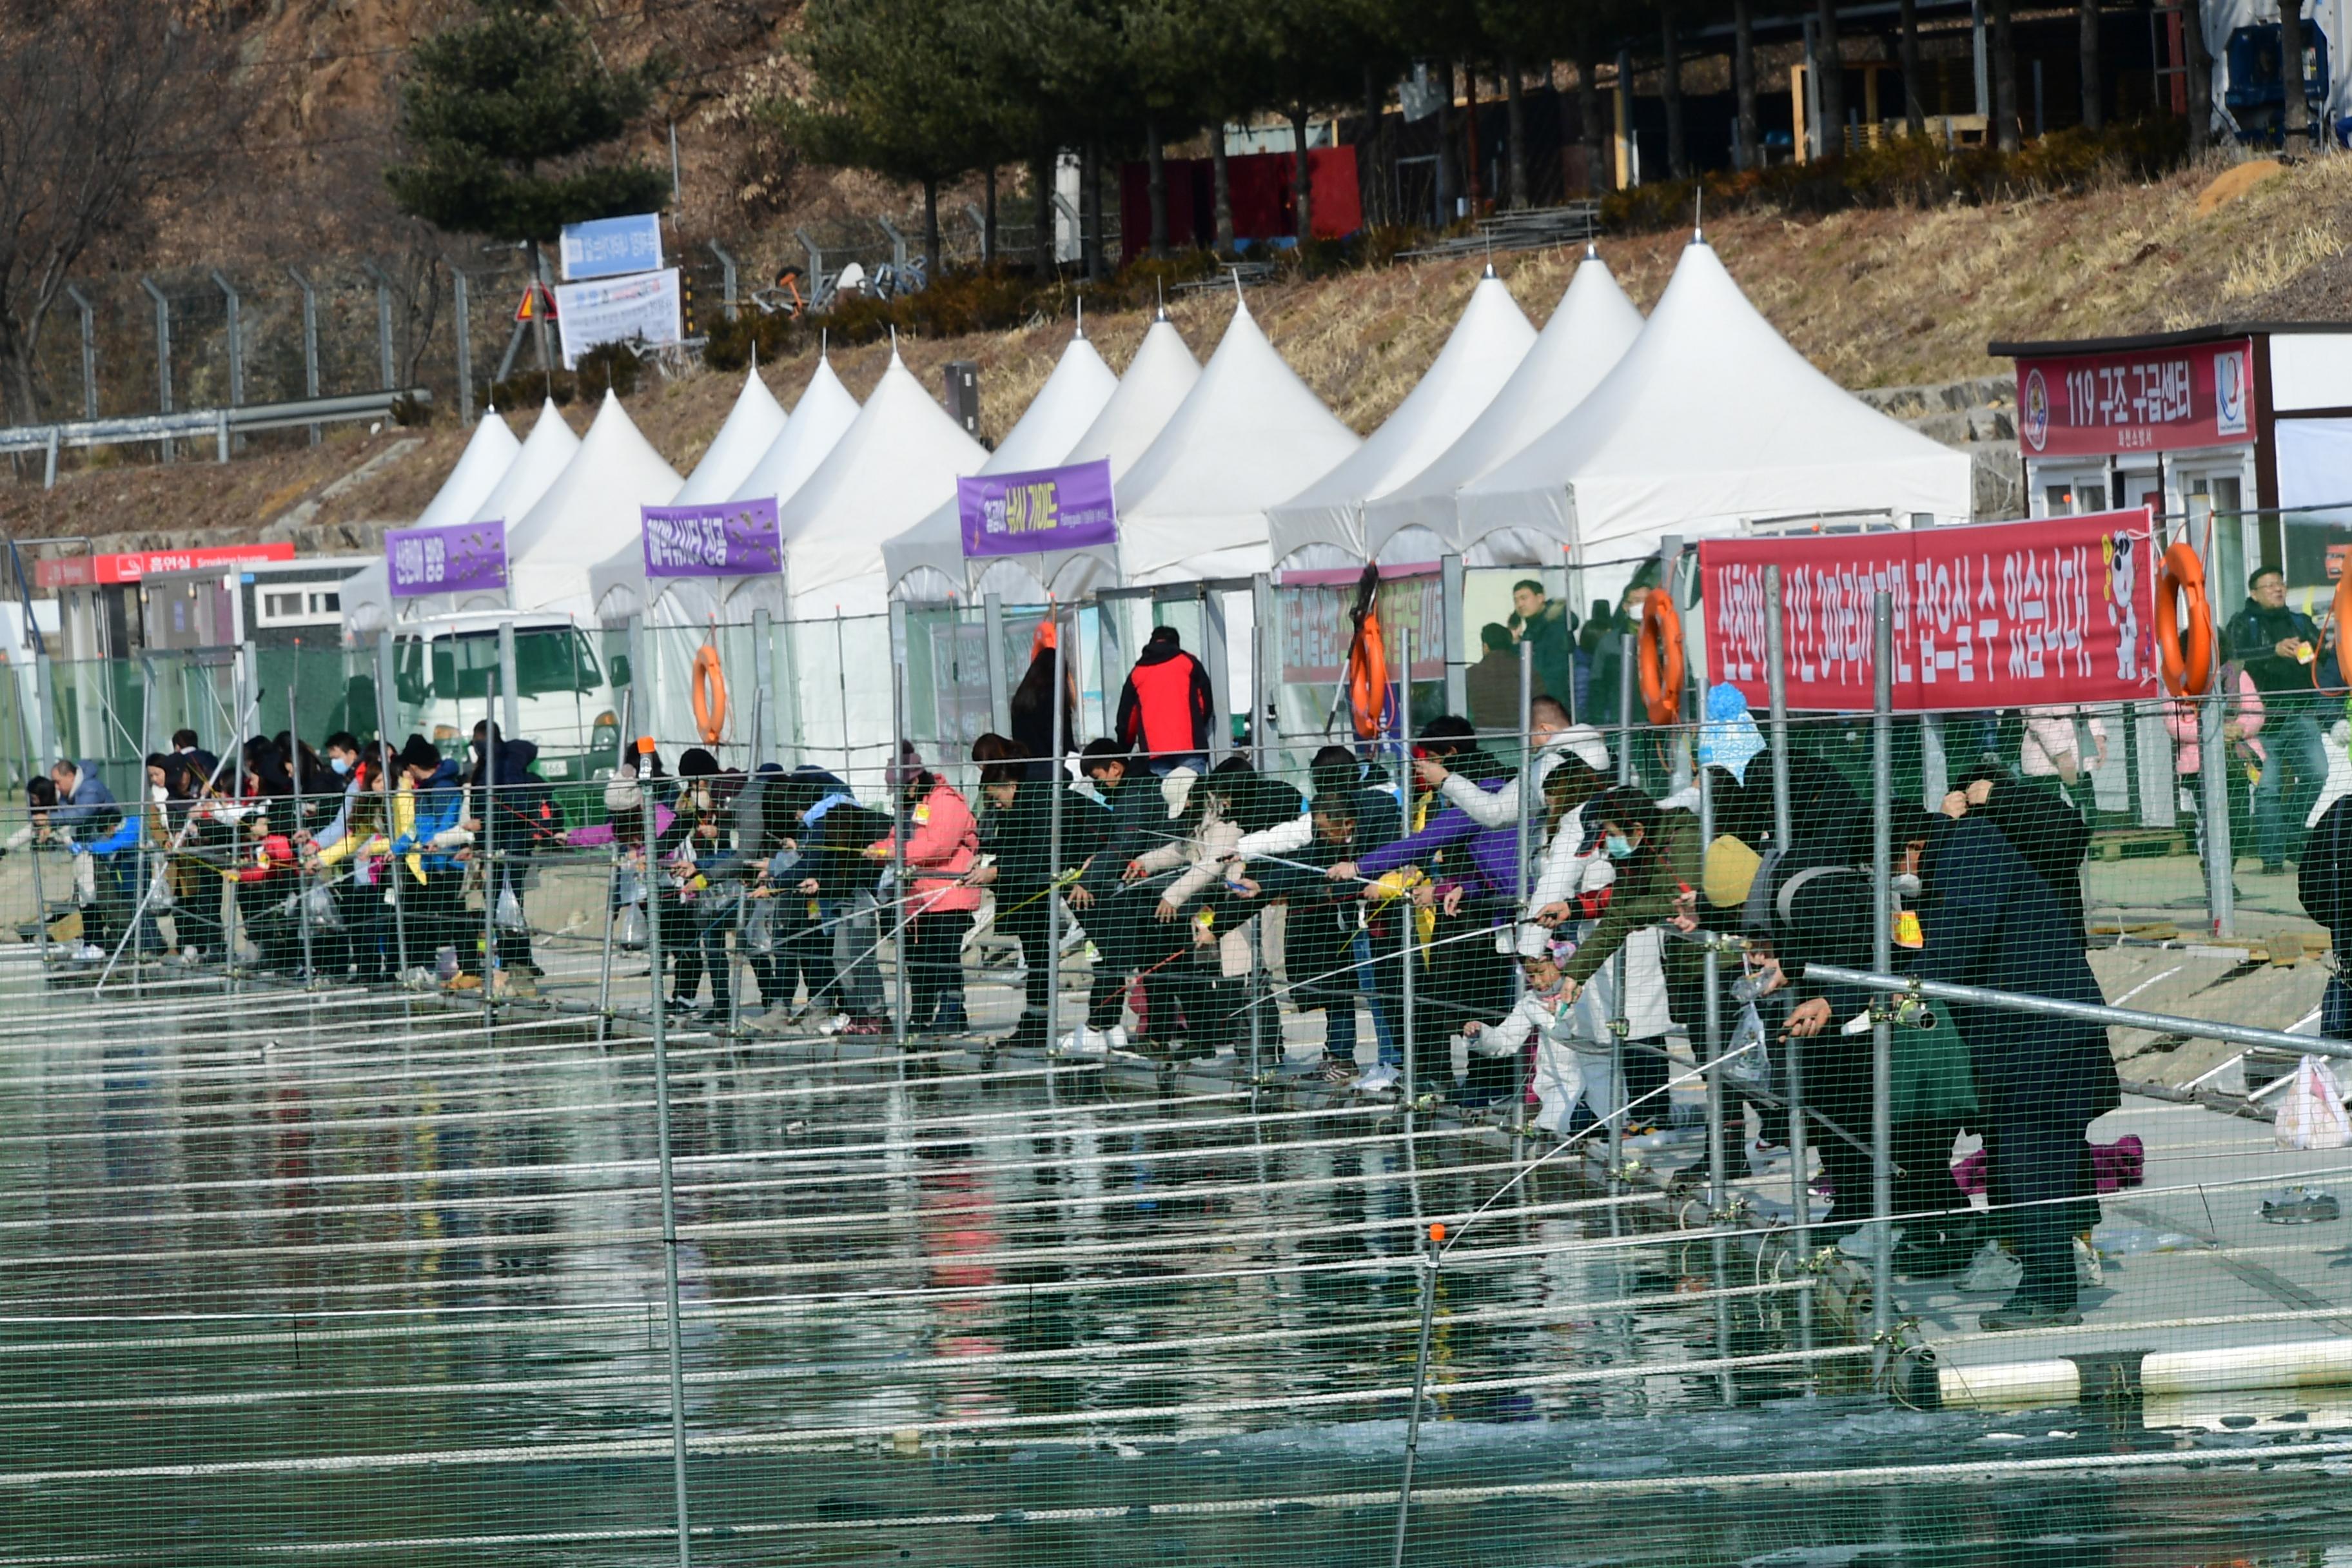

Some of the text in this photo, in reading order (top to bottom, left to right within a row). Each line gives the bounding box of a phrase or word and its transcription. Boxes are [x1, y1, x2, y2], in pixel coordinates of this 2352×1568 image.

[2066, 360, 2191, 426] 119 구조 구급센터
[1785, 564, 1816, 682] 1인
[1915, 555, 1975, 683] 잡으실
[1977, 554, 1999, 682] 수
[2003, 546, 2092, 680] 있습니다.
